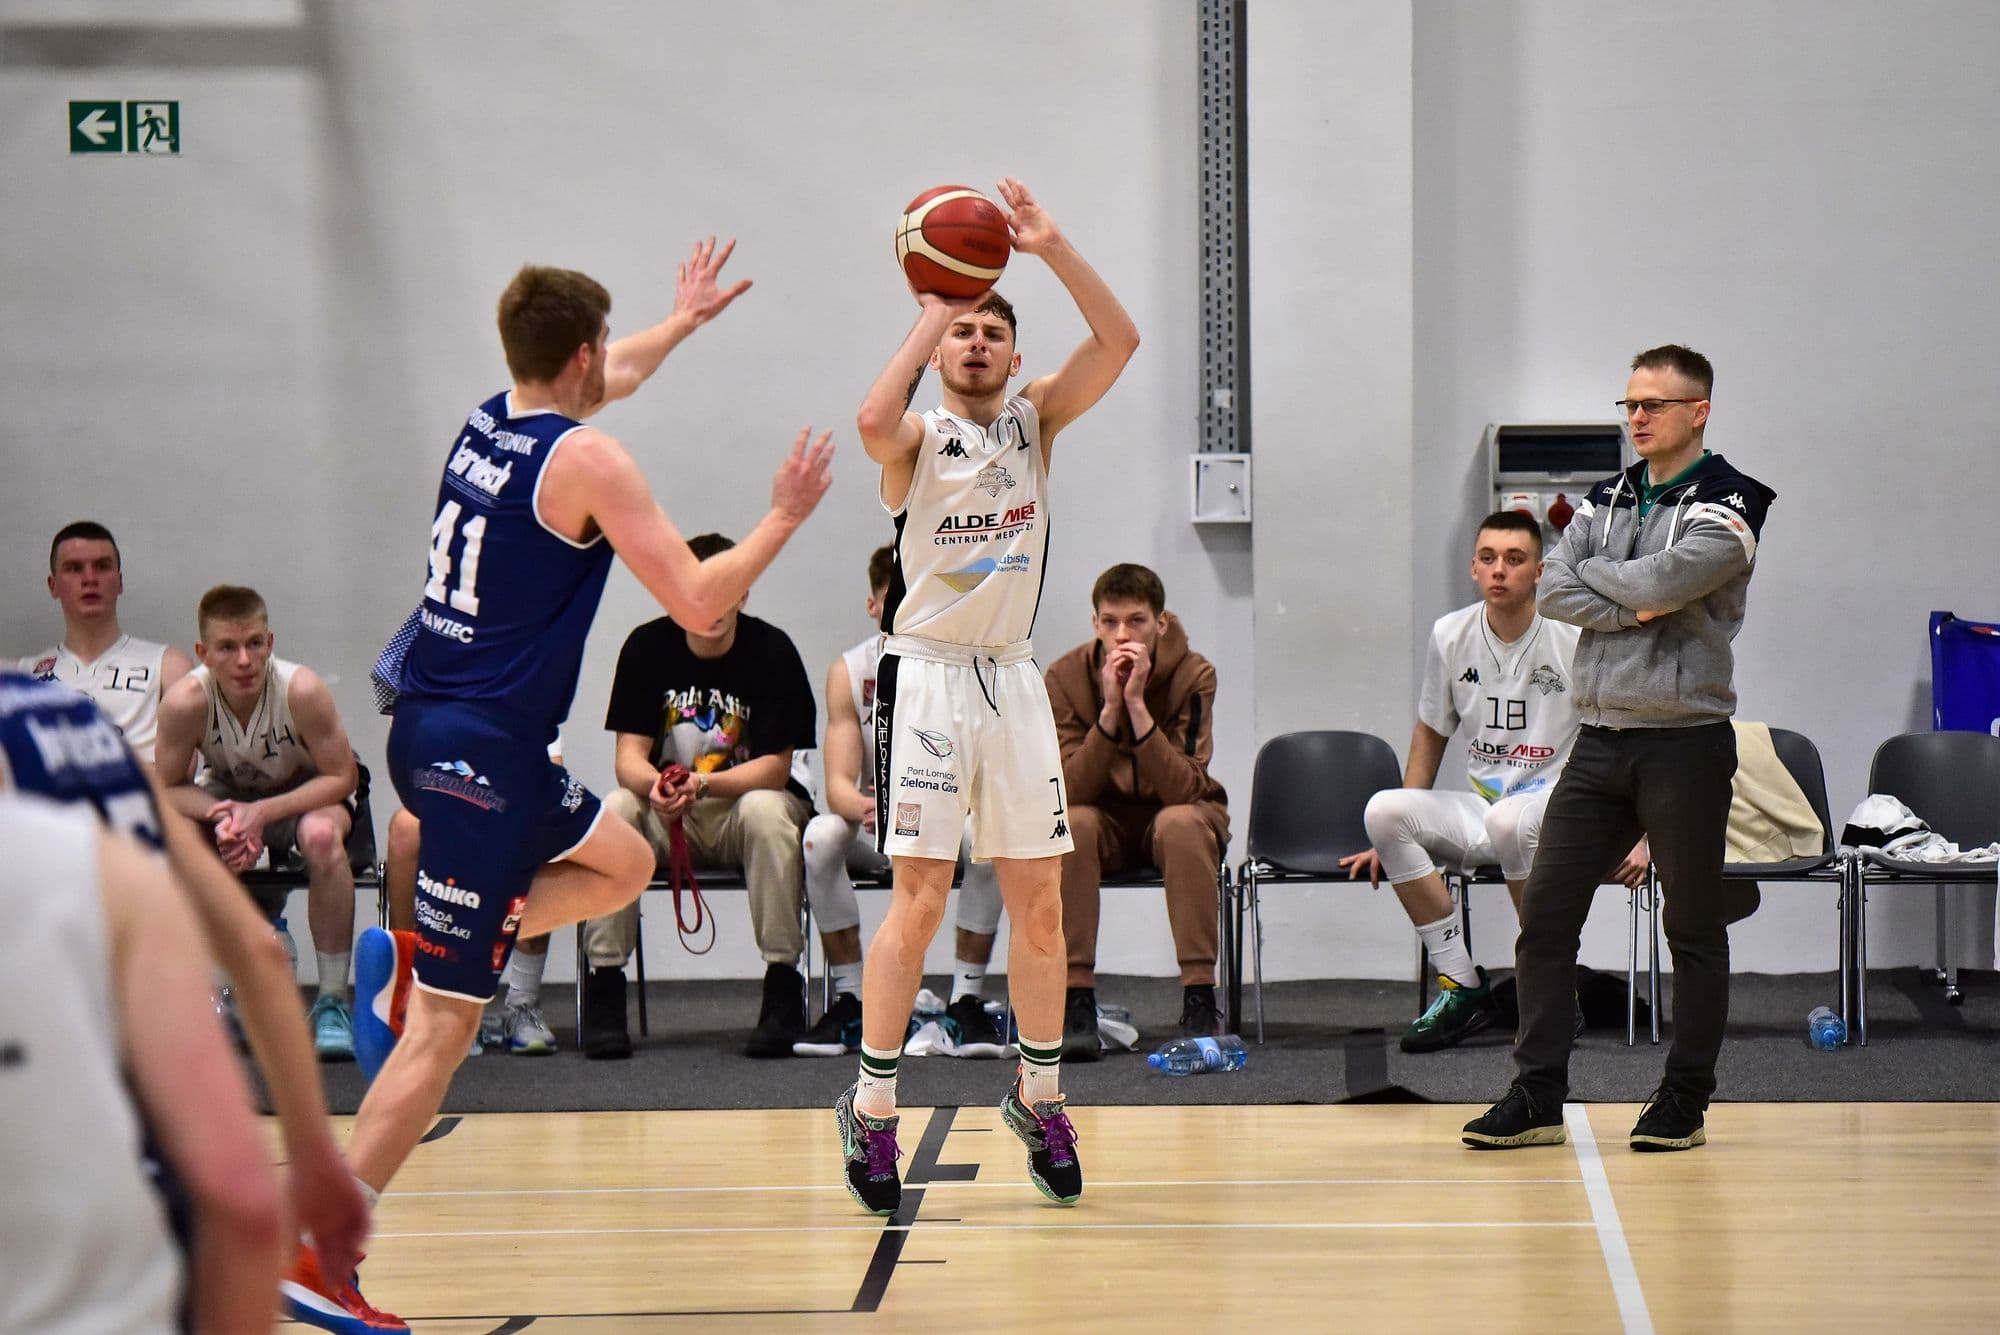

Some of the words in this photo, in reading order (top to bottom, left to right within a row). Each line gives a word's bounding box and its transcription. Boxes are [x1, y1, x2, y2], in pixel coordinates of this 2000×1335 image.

[1007, 416, 1030, 451] 1
[934, 534, 989, 546] CENTRUM
[424, 499, 487, 617] 41
[103, 665, 149, 694] 12
[1486, 696, 1528, 731] 18
[260, 723, 296, 761] 14
[876, 716, 890, 786] ZIELONA
[899, 776, 940, 791] Zielona
[906, 766, 925, 777] Port
[1049, 777, 1065, 816] 1
